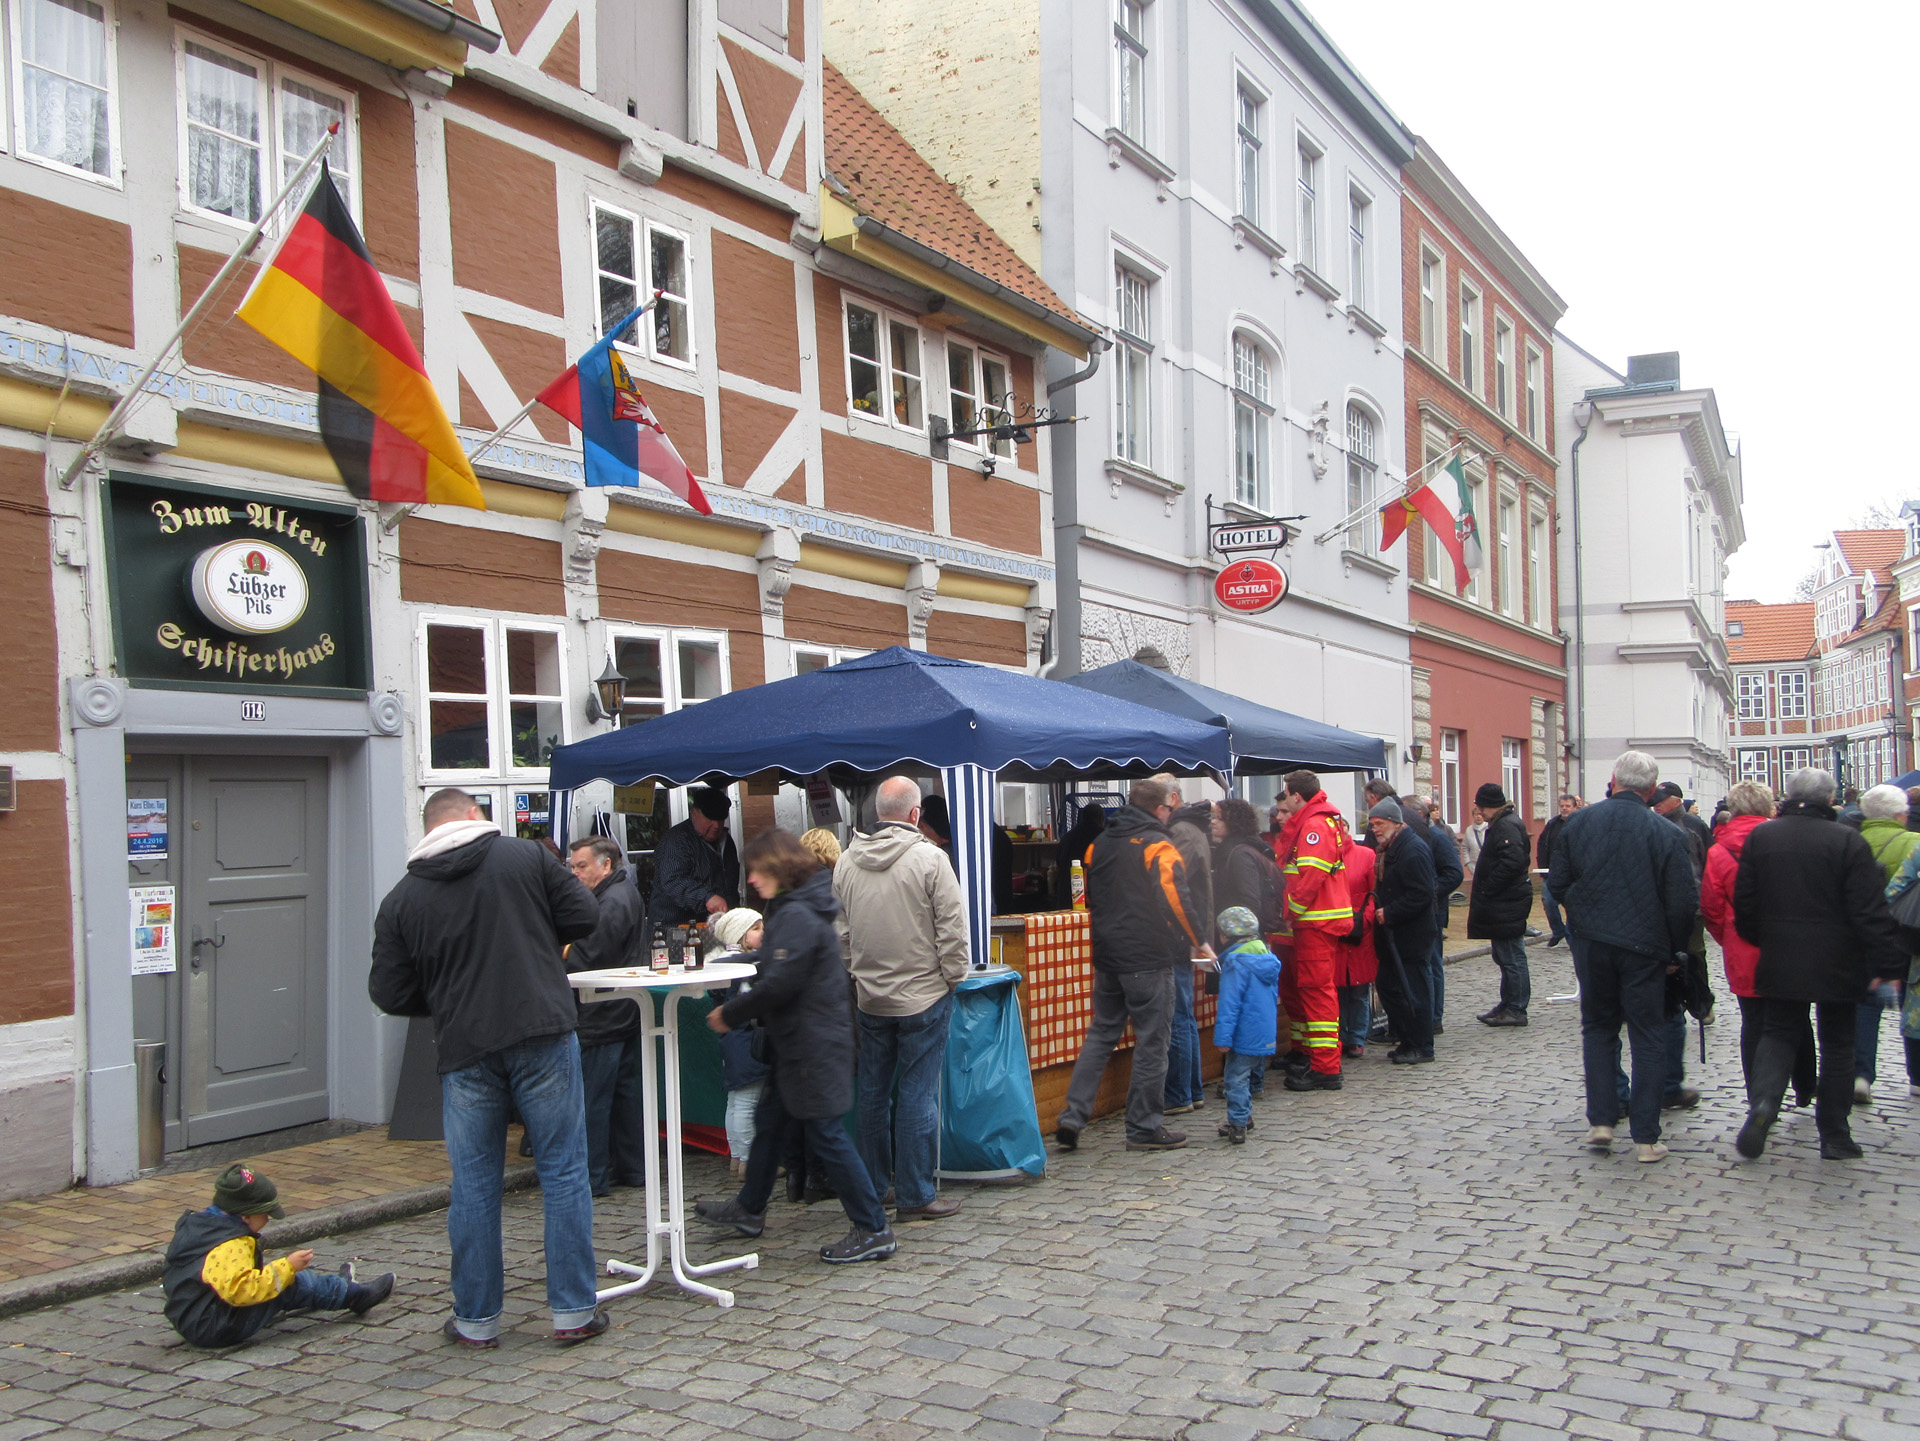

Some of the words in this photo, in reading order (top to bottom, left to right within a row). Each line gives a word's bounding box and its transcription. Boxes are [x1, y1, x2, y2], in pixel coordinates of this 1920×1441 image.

[236, 392, 304, 422] GOTT
[151, 499, 232, 534] Zum
[246, 502, 328, 557] Alten
[1220, 529, 1278, 546] HOTEL
[226, 572, 287, 601] Lübzer
[1228, 584, 1268, 595] ASTRA
[244, 597, 272, 615] Pils
[1235, 598, 1260, 606] URTYP
[157, 622, 336, 680] Schifferhaus
[244, 703, 263, 719] 114
[130, 800, 143, 810] Kurs
[156, 800, 166, 811] Tag
[133, 837, 163, 845] 24.4.2016
